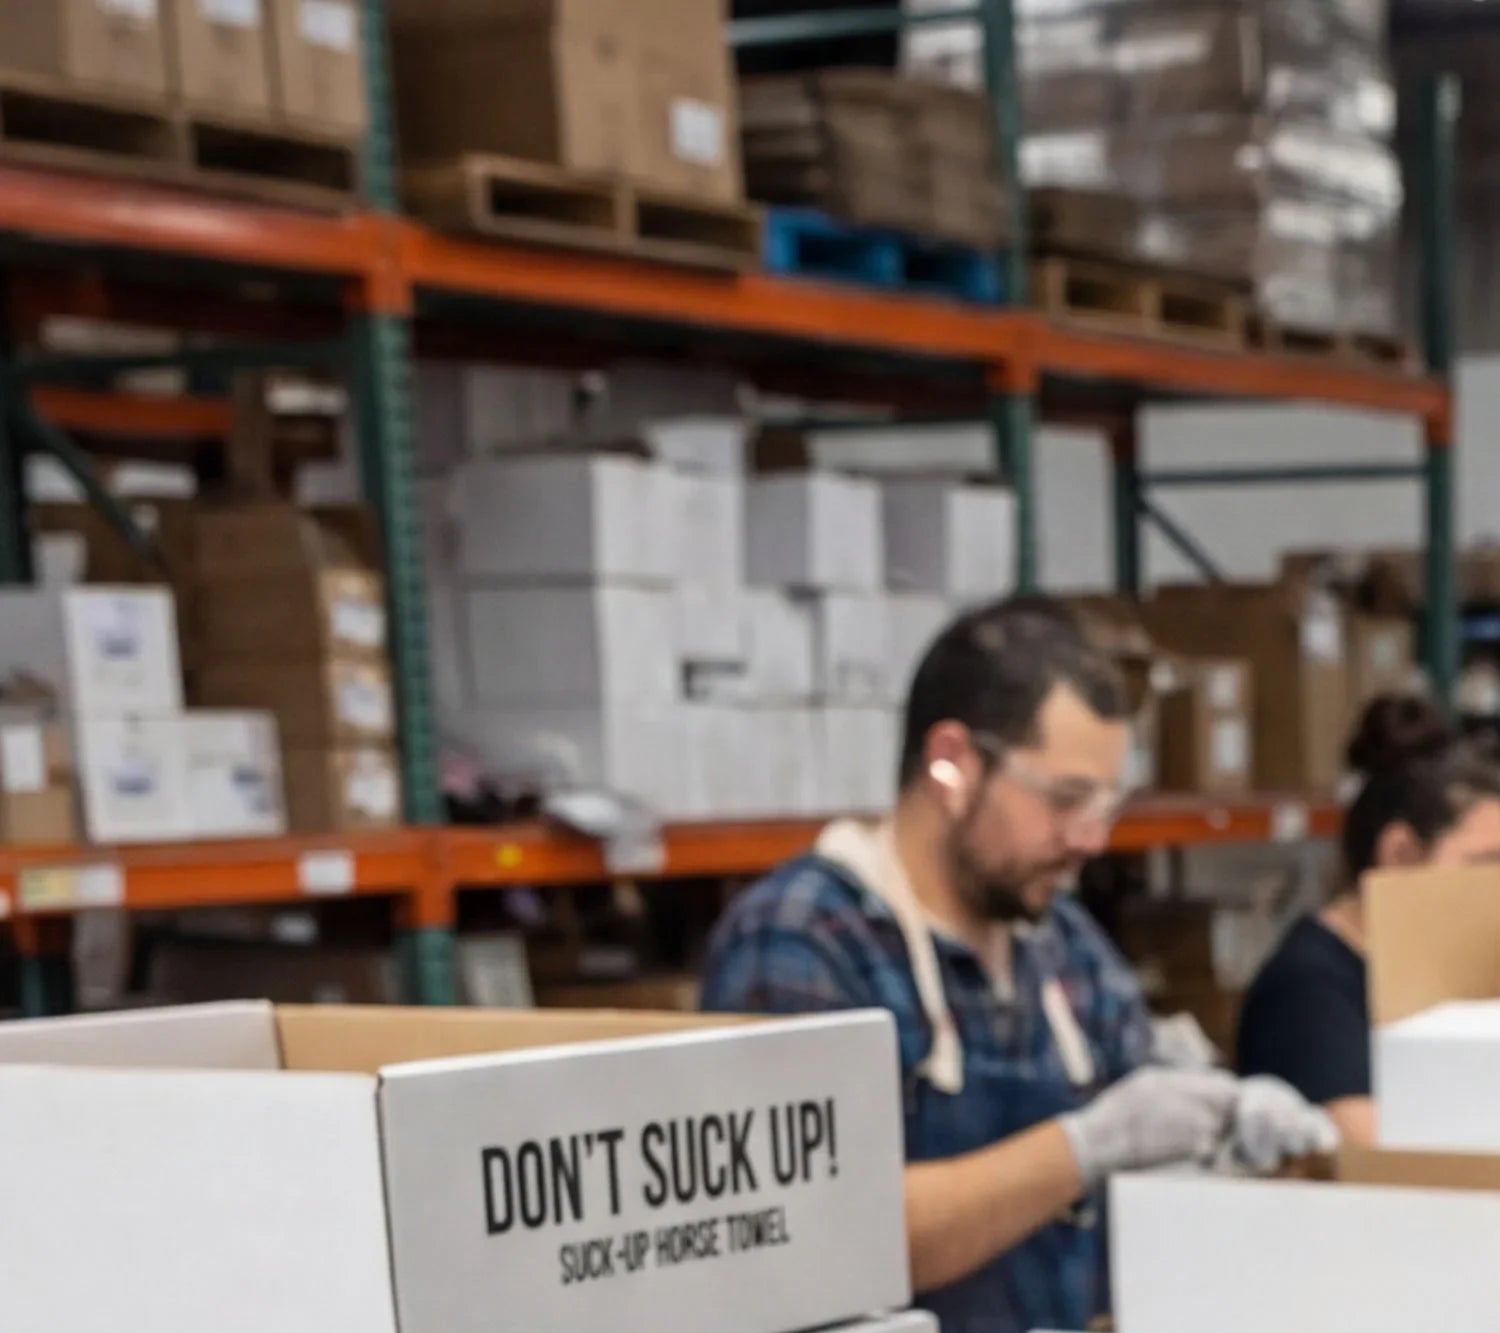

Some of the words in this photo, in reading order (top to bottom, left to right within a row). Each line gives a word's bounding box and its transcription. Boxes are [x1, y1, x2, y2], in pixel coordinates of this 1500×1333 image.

[482, 1129, 624, 1235] DON'T
[640, 1110, 757, 1208] SUCK
[770, 1097, 838, 1187] UP!
[560, 1230, 650, 1285] SUCK-UP
[657, 1217, 720, 1265] HORSE
[728, 1207, 790, 1252] TOWEL
